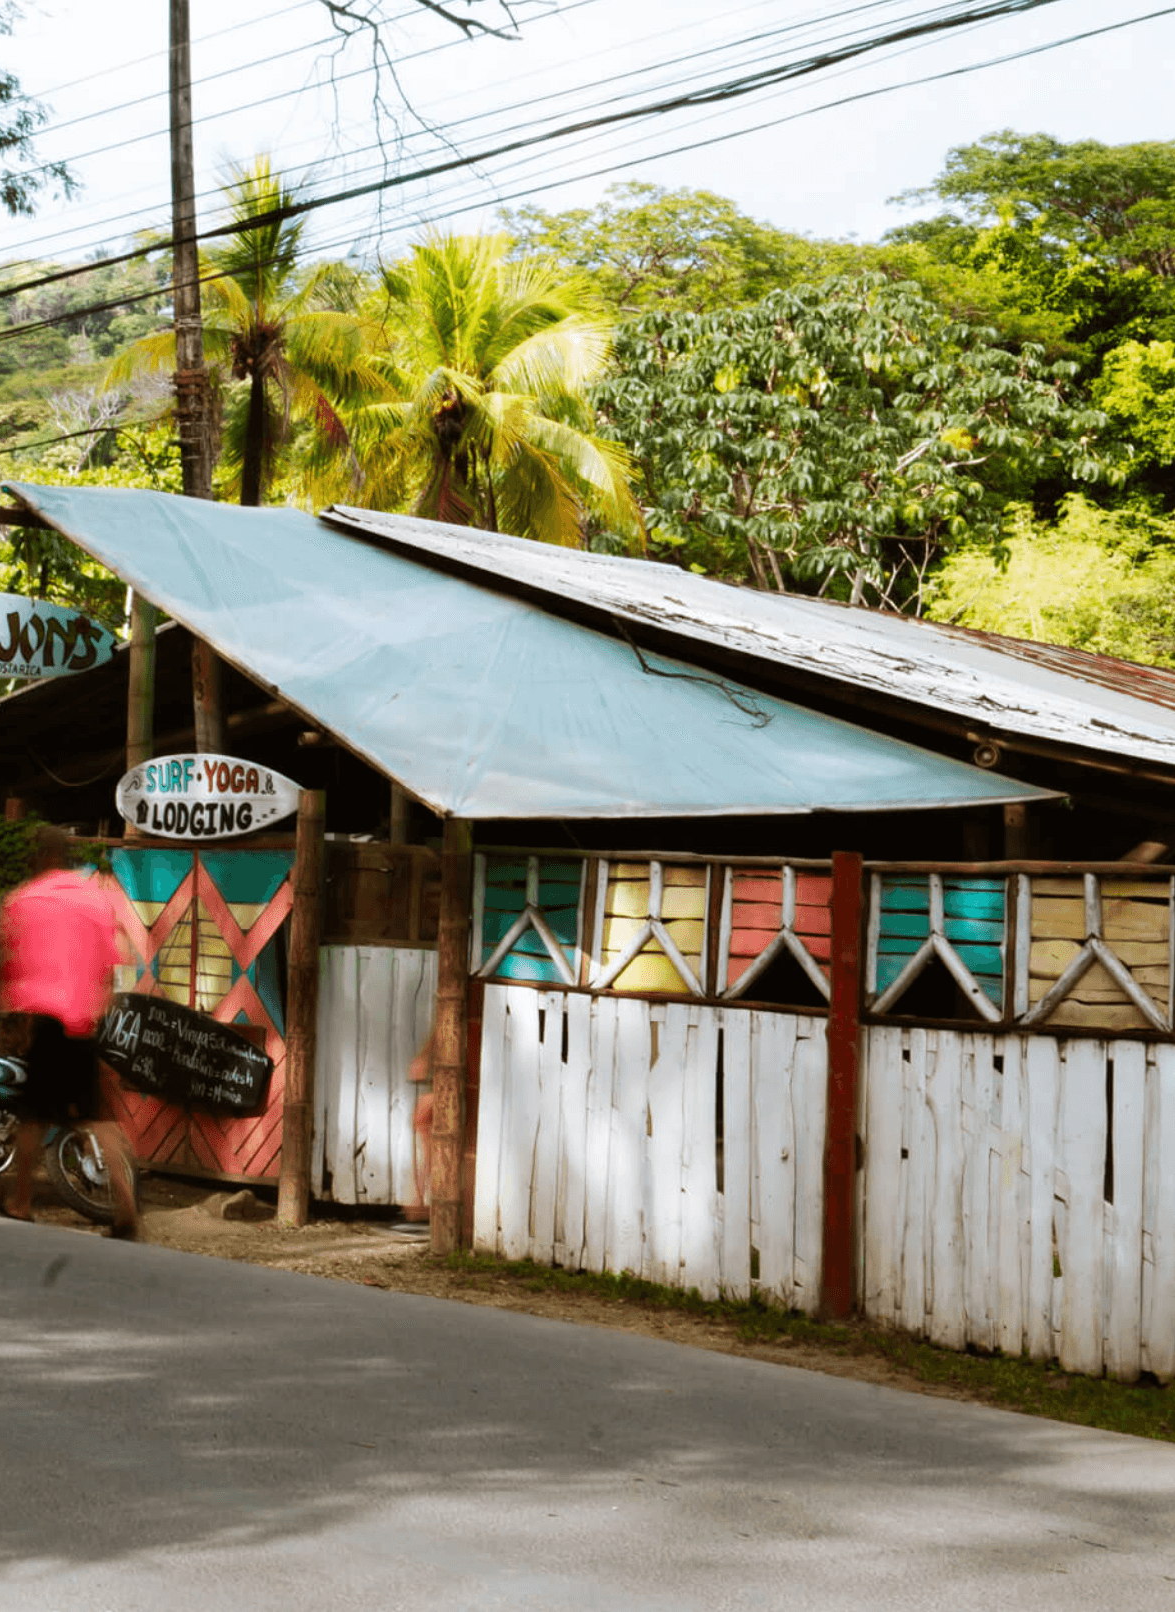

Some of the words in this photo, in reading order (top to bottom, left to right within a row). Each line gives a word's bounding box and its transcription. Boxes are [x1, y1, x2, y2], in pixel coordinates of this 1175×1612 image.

[145, 758, 195, 793] SURF
[203, 760, 260, 794] YOGA
[151, 801, 253, 836] LODGING
[99, 1005, 141, 1053] YOGA
